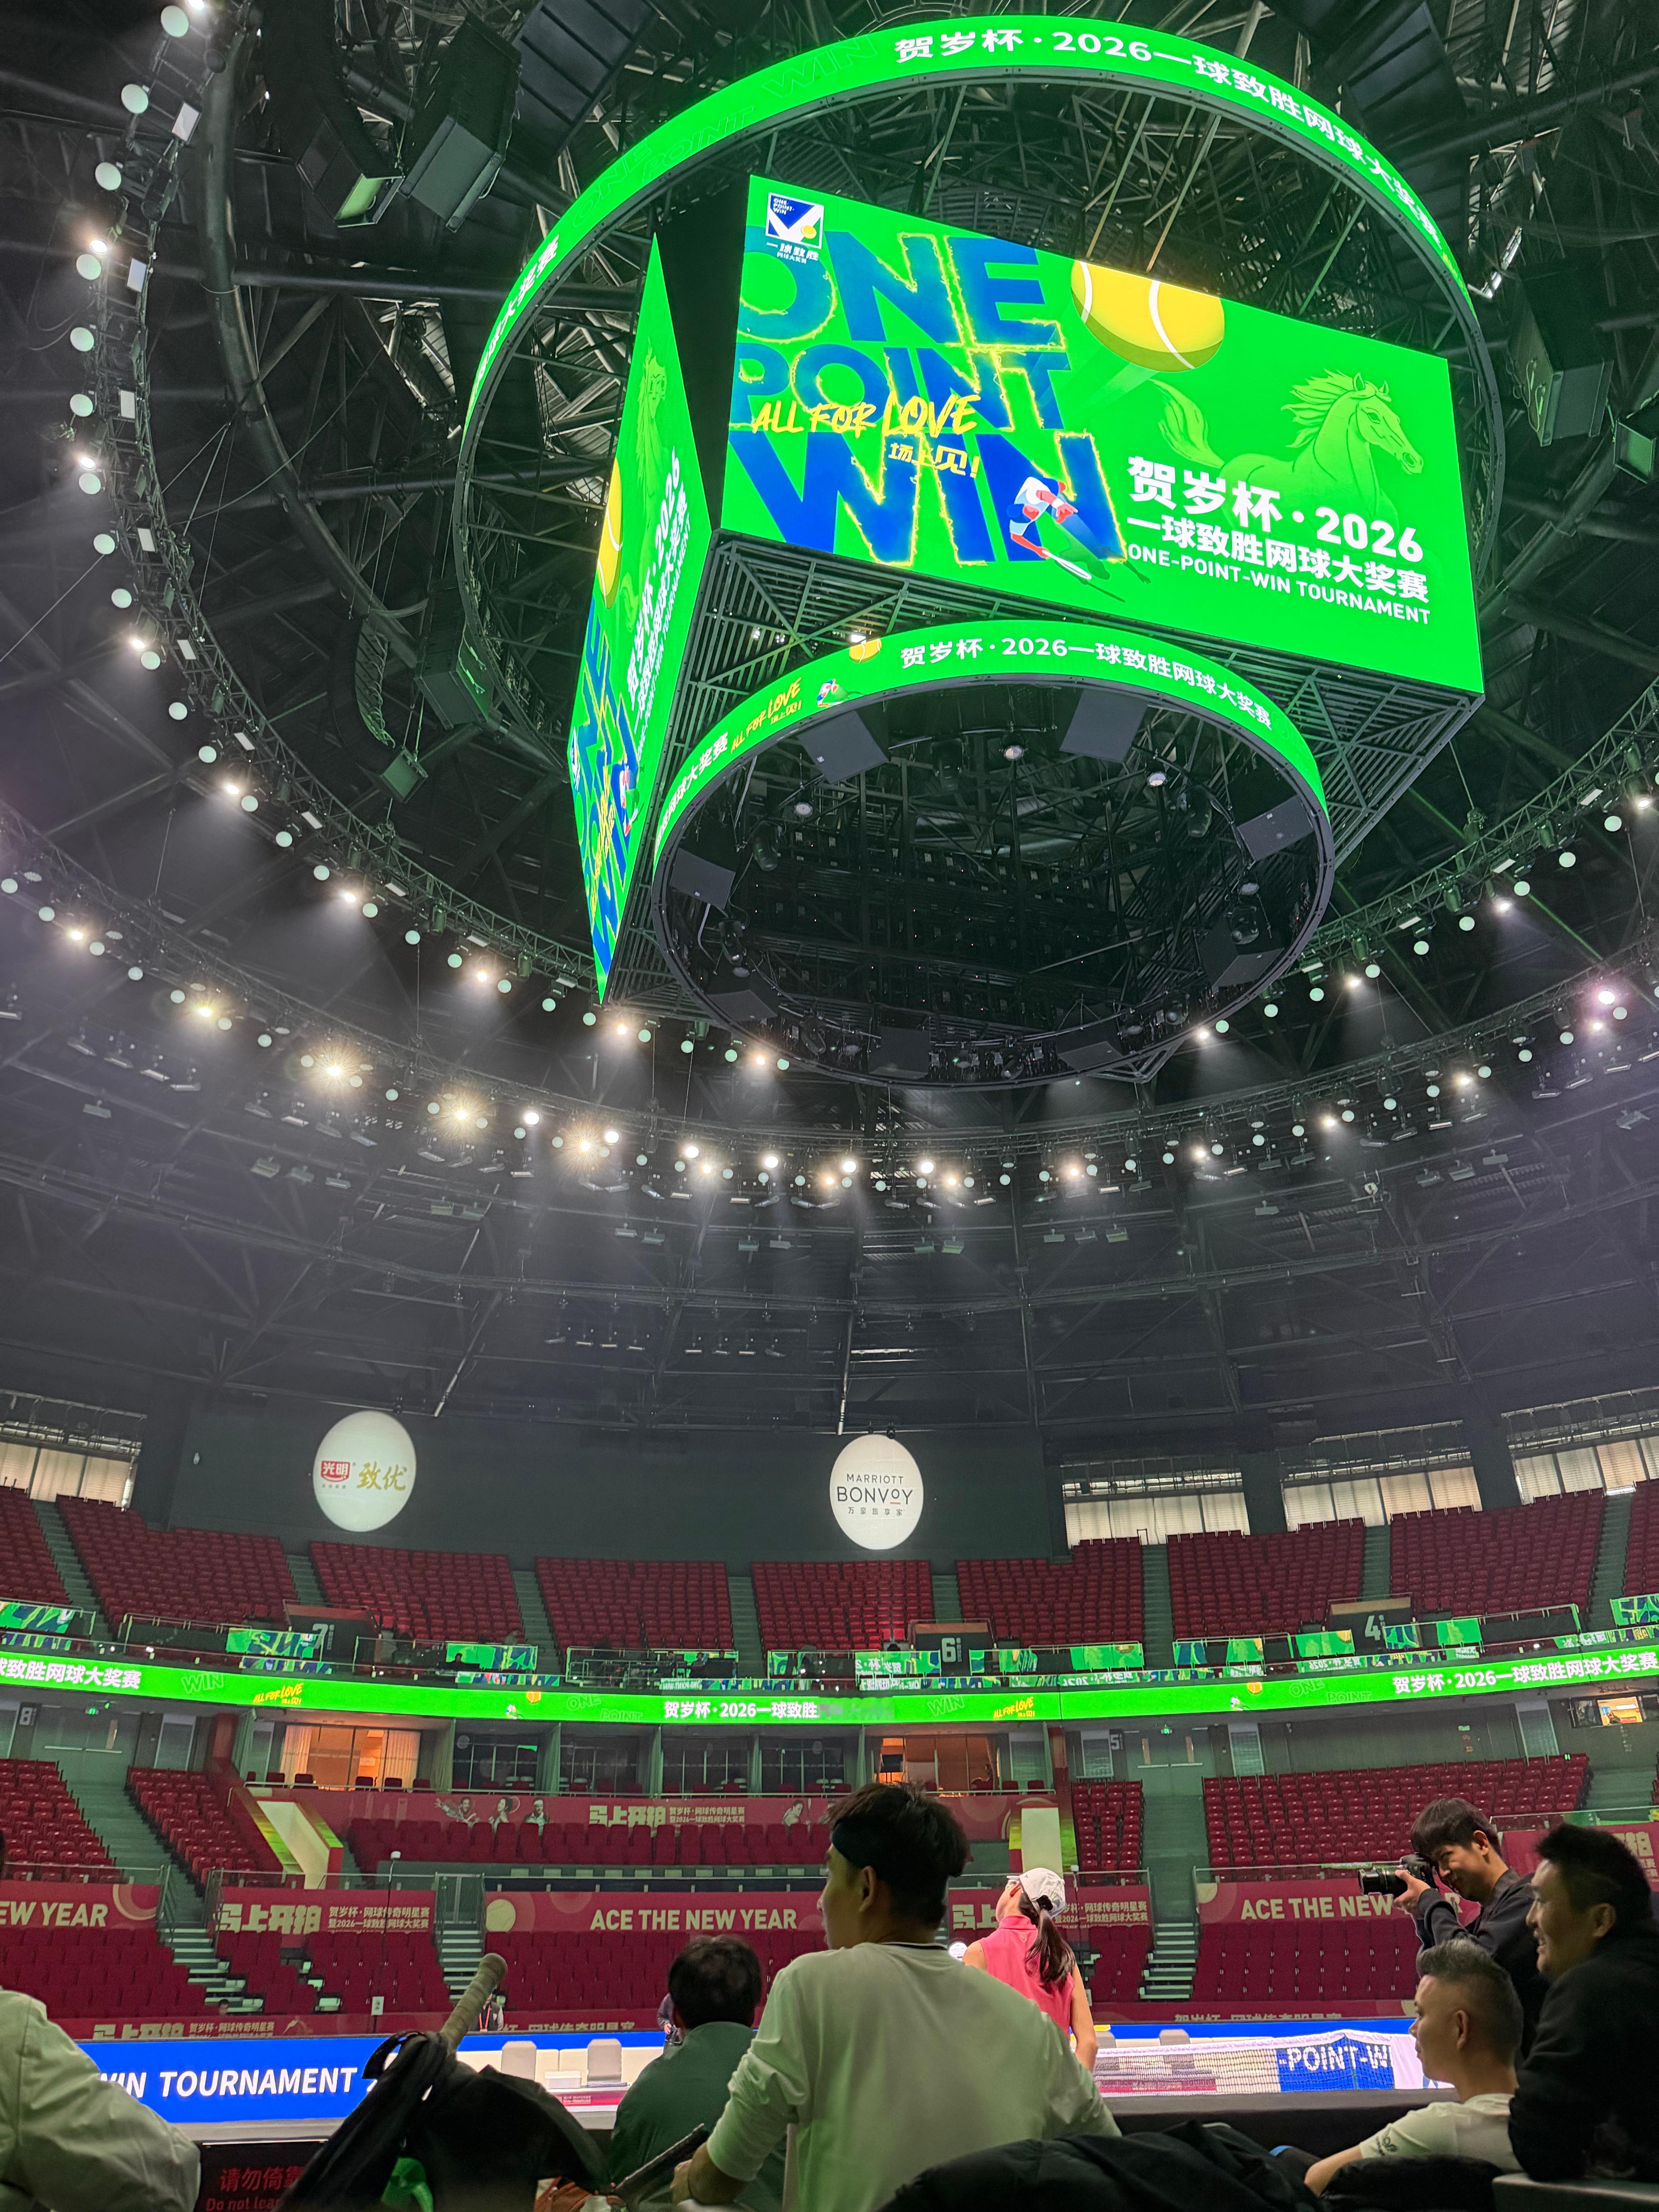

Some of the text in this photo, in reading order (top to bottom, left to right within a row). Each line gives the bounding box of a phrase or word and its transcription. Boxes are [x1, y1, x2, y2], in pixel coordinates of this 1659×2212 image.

[737, 226, 1066, 350] ONE
[729, 342, 1072, 433] POINT
[752, 390, 982, 440] ALL FOR LOVE
[729, 430, 1128, 567] WIN
[1127, 515, 1430, 604] 一球致胜网球大奖赛
[1128, 543, 1431, 625] ONE-POINT-WIN TOURNAMENT
[767, 676, 802, 719] LOVE
[323, 1462, 349, 1476] 光明
[847, 1473, 904, 1485] MARRIOTT
[837, 1486, 913, 1504] BONVOY
[280, 1682, 304, 1698] LOVE
[1015, 1696, 1034, 1713] LOVE
[41, 1902, 108, 1927] YEAR
[590, 1908, 797, 1930] ACE THE NEW YEAR
[1241, 1894, 1393, 1920] ACE THE NEW
[159, 2067, 358, 2098] TOURNAMENT
[228, 2197, 249, 2211] not
